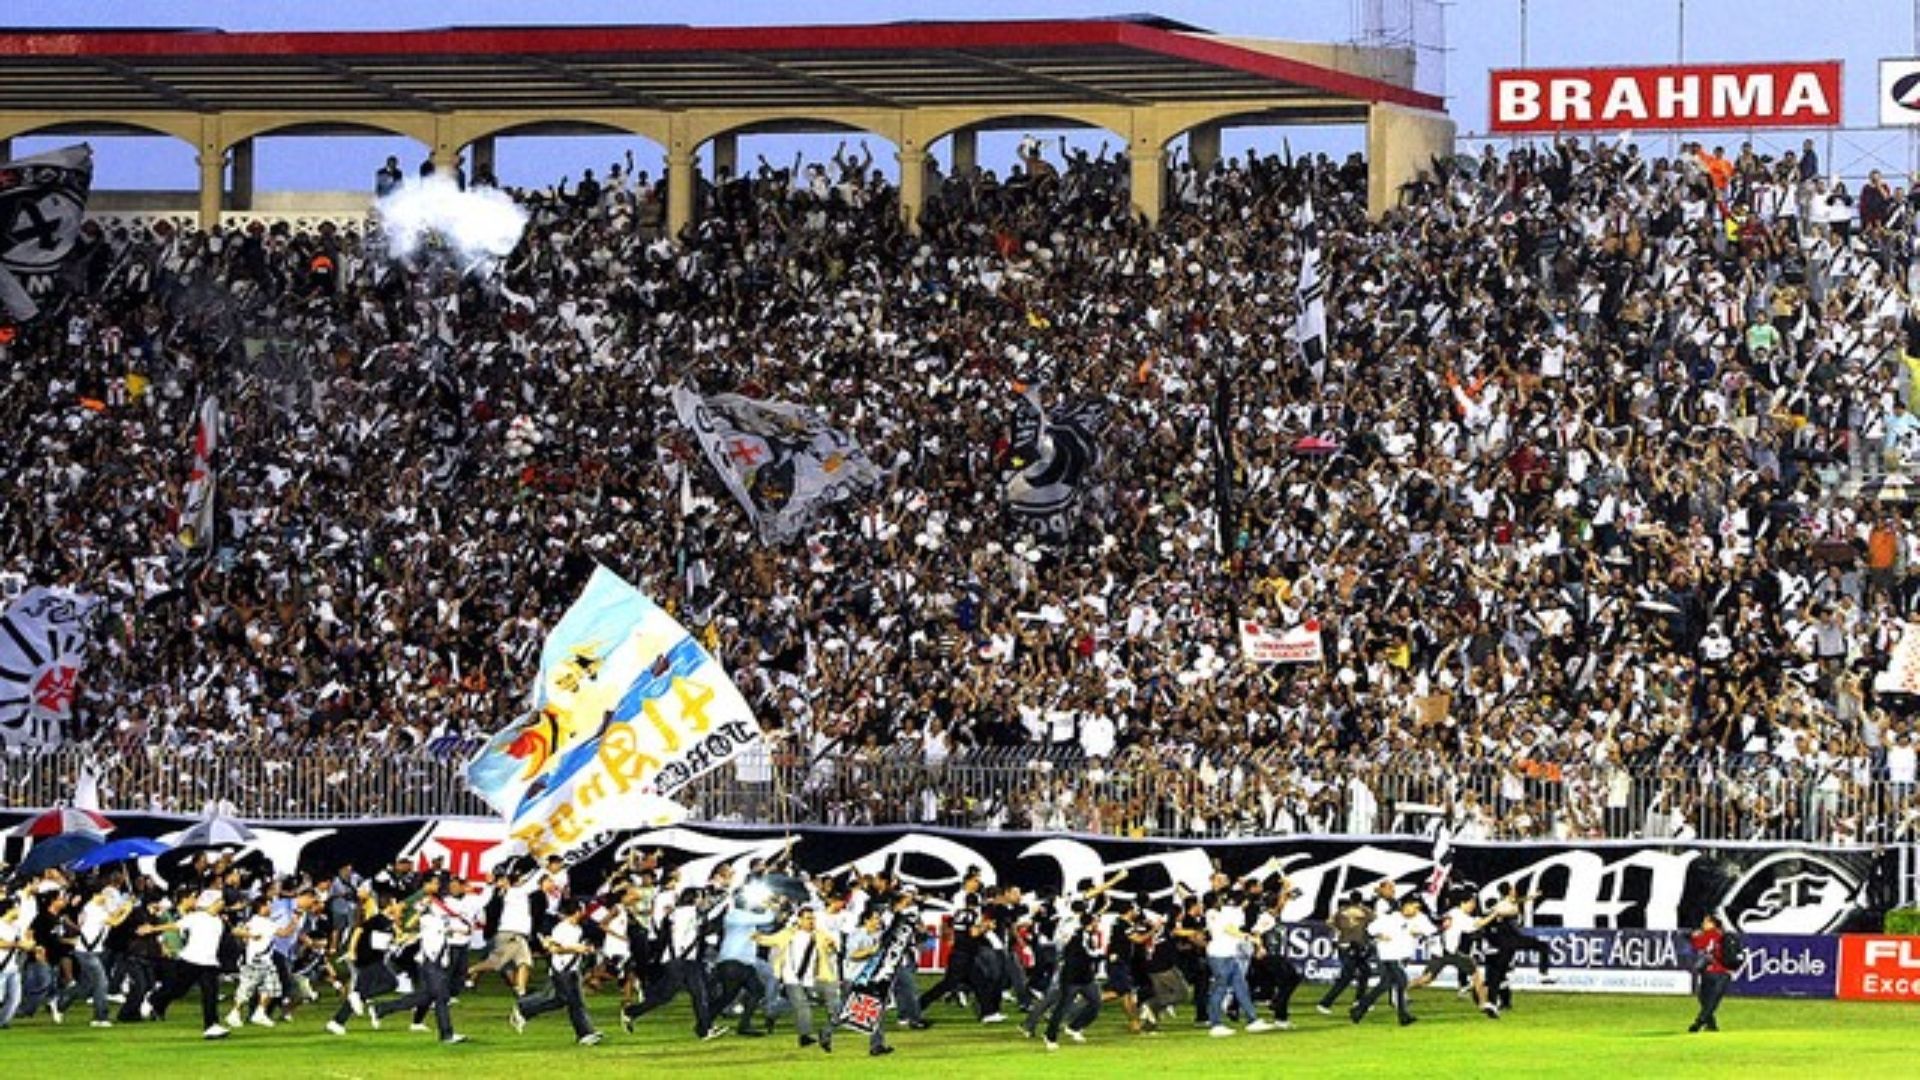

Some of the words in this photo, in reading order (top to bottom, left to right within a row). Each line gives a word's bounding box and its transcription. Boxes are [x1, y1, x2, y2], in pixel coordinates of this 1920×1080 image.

[1498, 71, 1830, 122] BRAHMA
[1571, 934, 1605, 967] DE
[1608, 930, 1678, 967] ÁGUA
